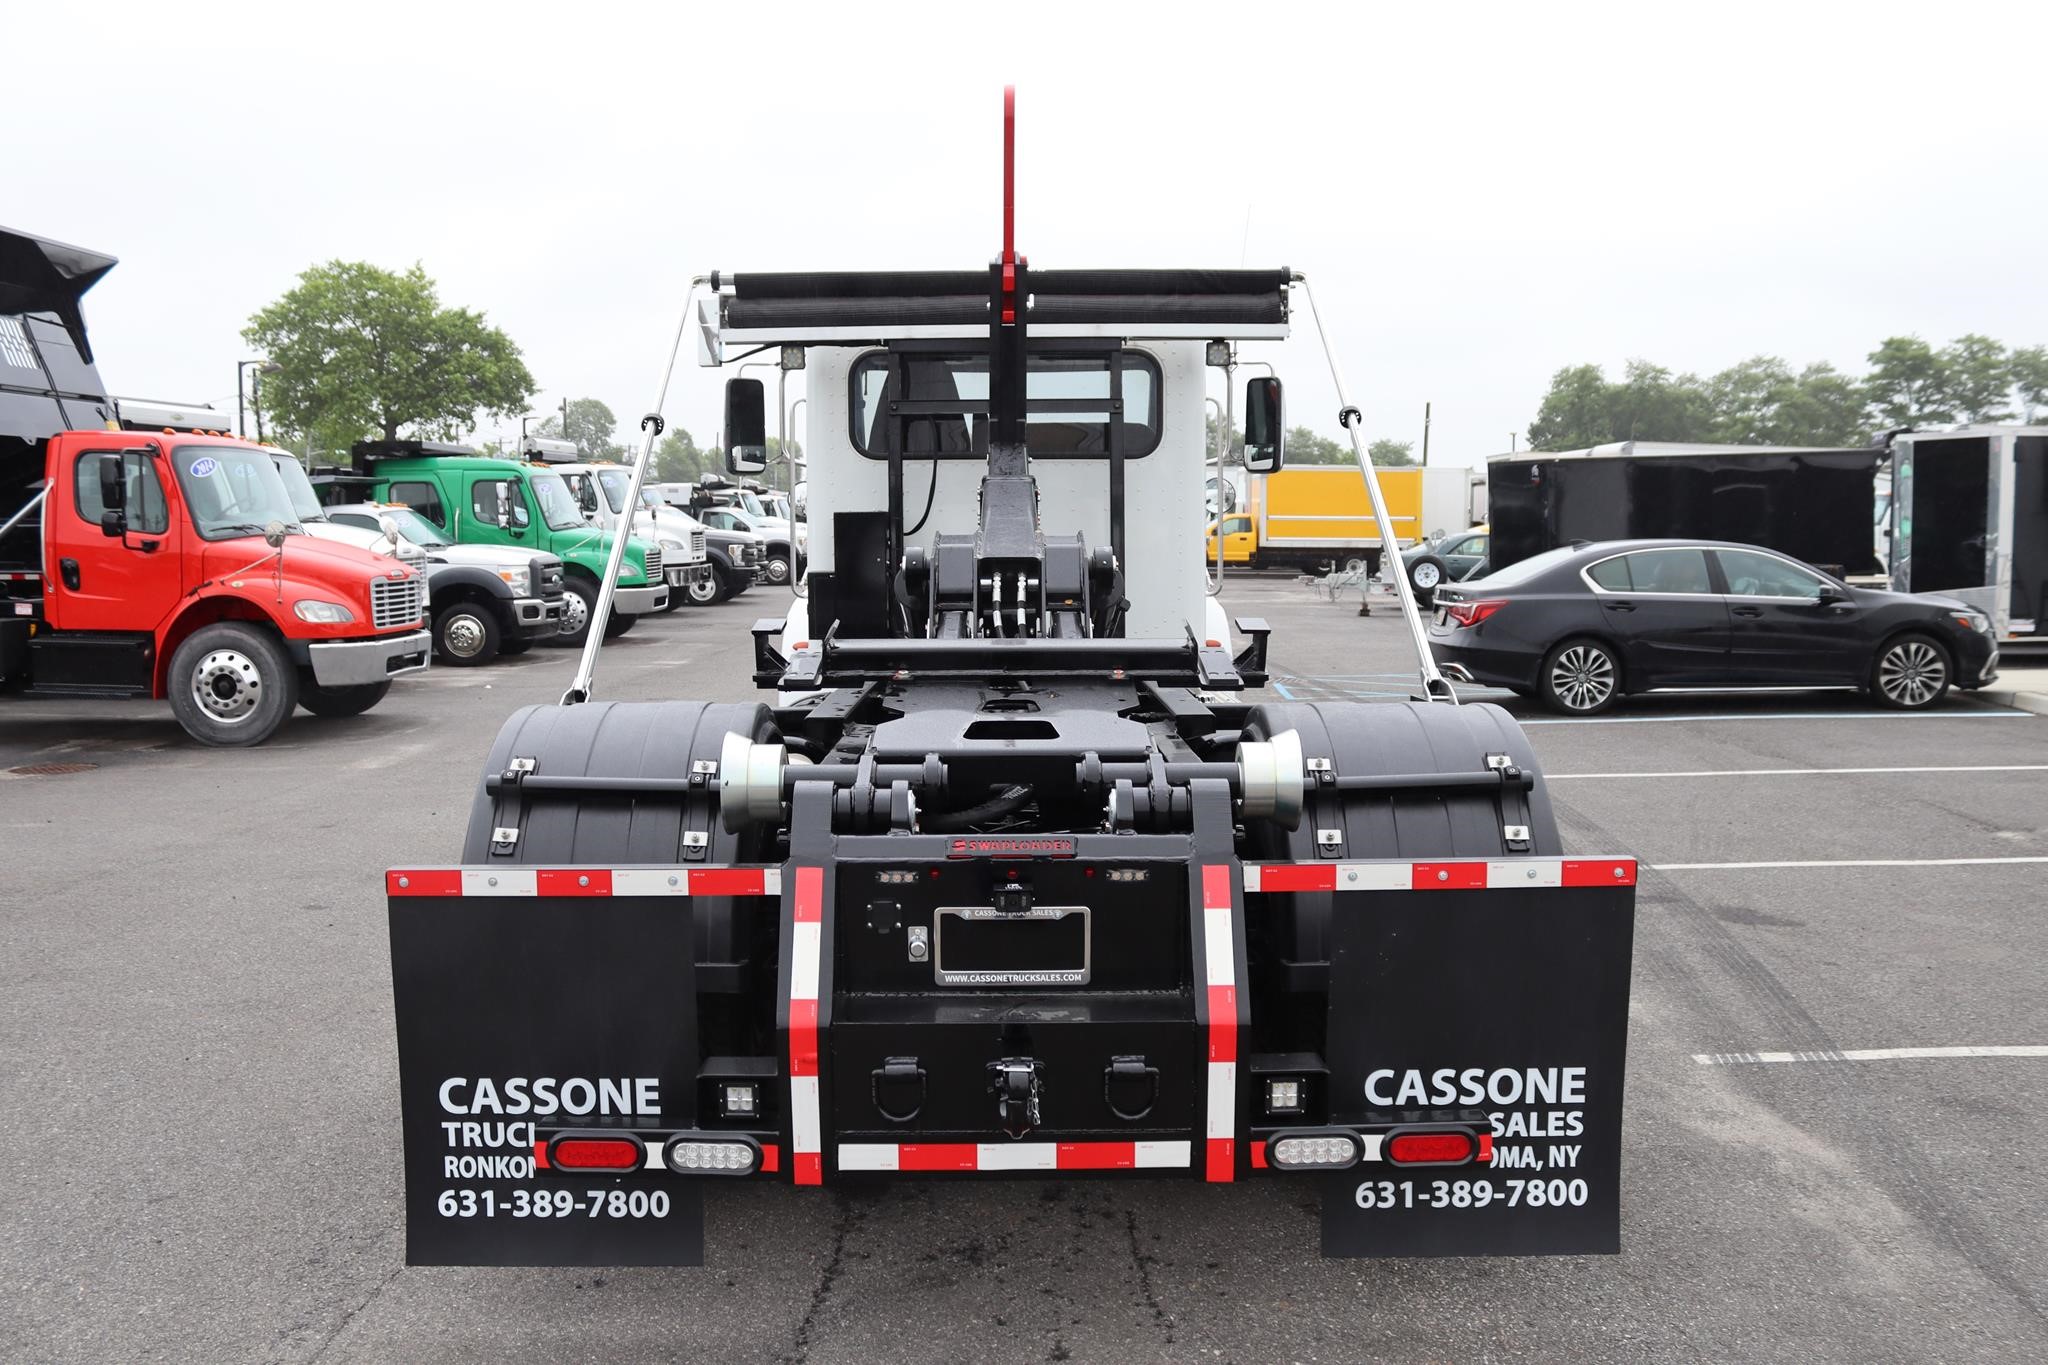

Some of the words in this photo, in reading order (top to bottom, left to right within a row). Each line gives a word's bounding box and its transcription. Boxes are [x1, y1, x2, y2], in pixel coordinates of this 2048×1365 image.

[969, 839, 1072, 850] SWAPLOADER
[944, 973, 1082, 983] WWW.CASSONETRUCKSALES.COM
[438, 1077, 662, 1115] CASSONE
[1364, 1066, 1586, 1105] CASSONE
[1491, 1111, 1584, 1138] SALES
[1548, 1144, 1582, 1168] NY
[437, 1189, 670, 1218] 631-389-7800
[1355, 1179, 1589, 1209] 631-389-7800
